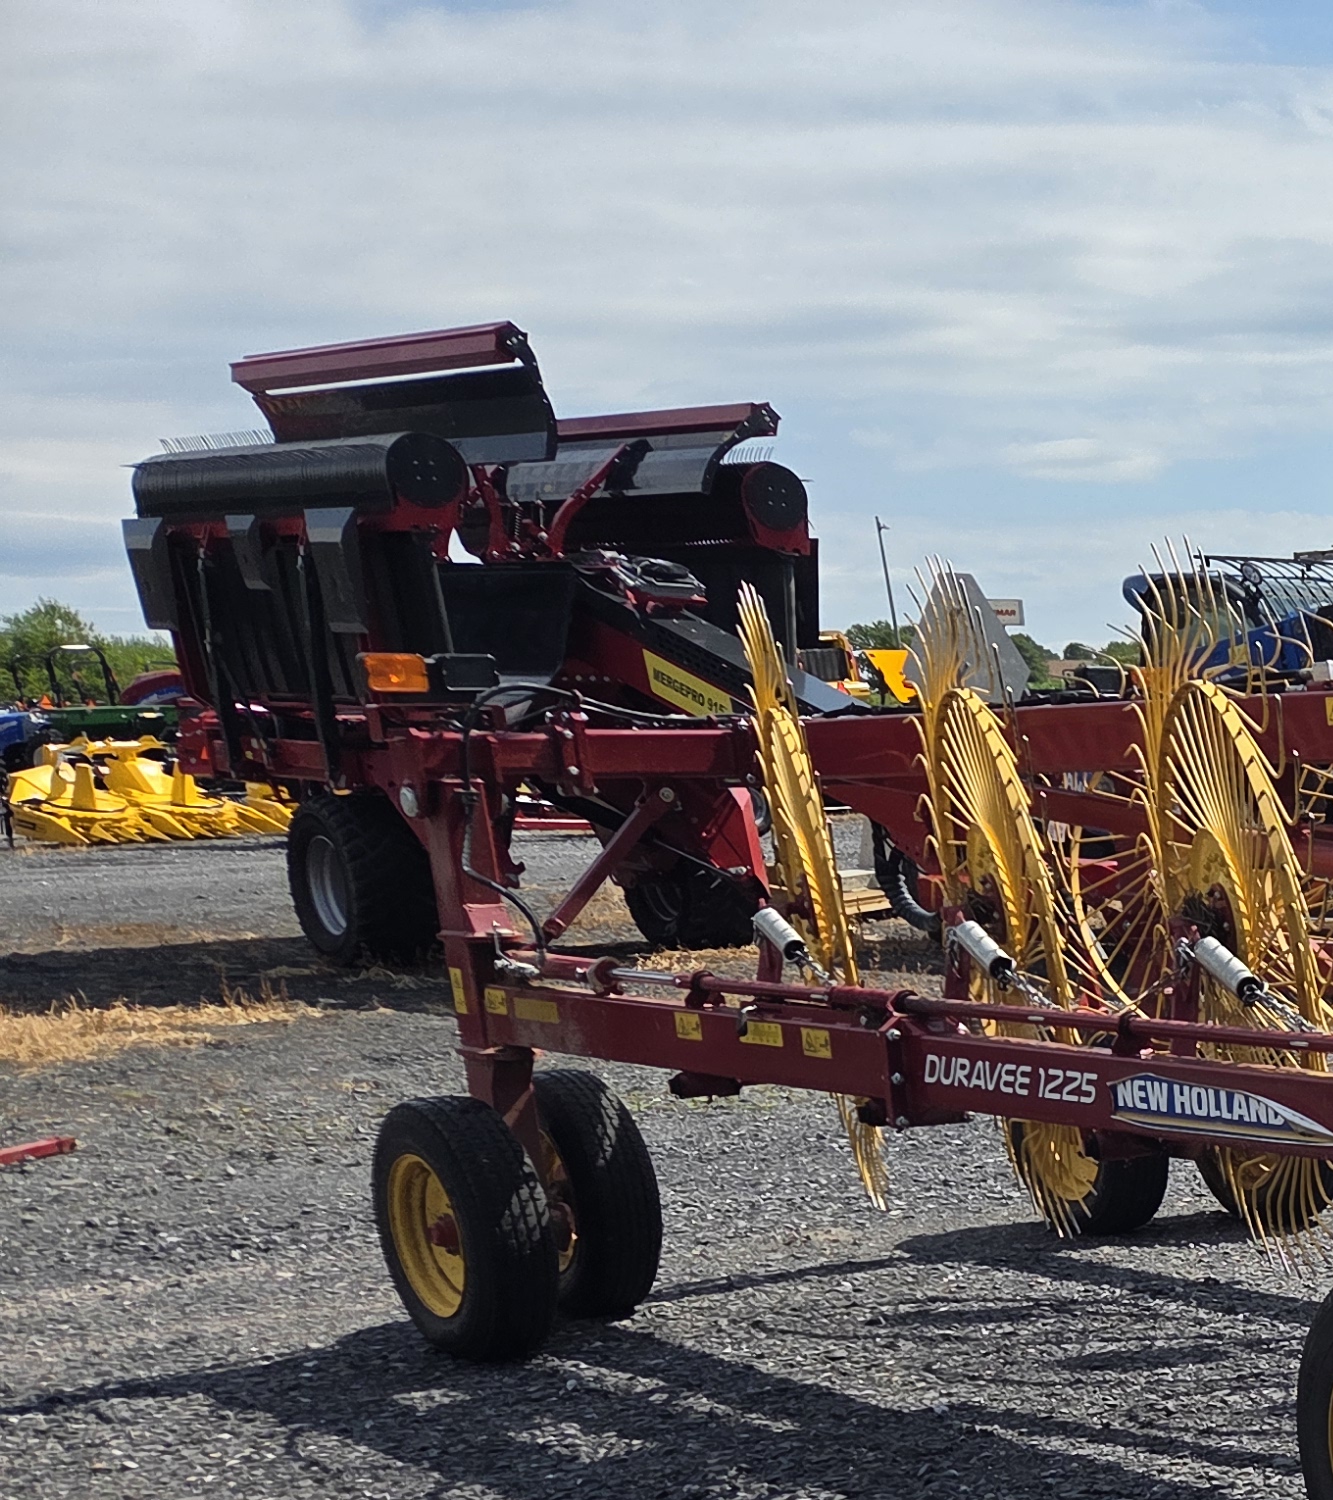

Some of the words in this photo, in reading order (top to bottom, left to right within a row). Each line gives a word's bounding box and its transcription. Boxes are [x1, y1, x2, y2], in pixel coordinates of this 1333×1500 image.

[924, 1054, 1032, 1096] DURAVEE
[1038, 1067, 1098, 1104] 1225
[1117, 1079, 1168, 1113] NEW
[1173, 1083, 1286, 1126] HOLLAND
